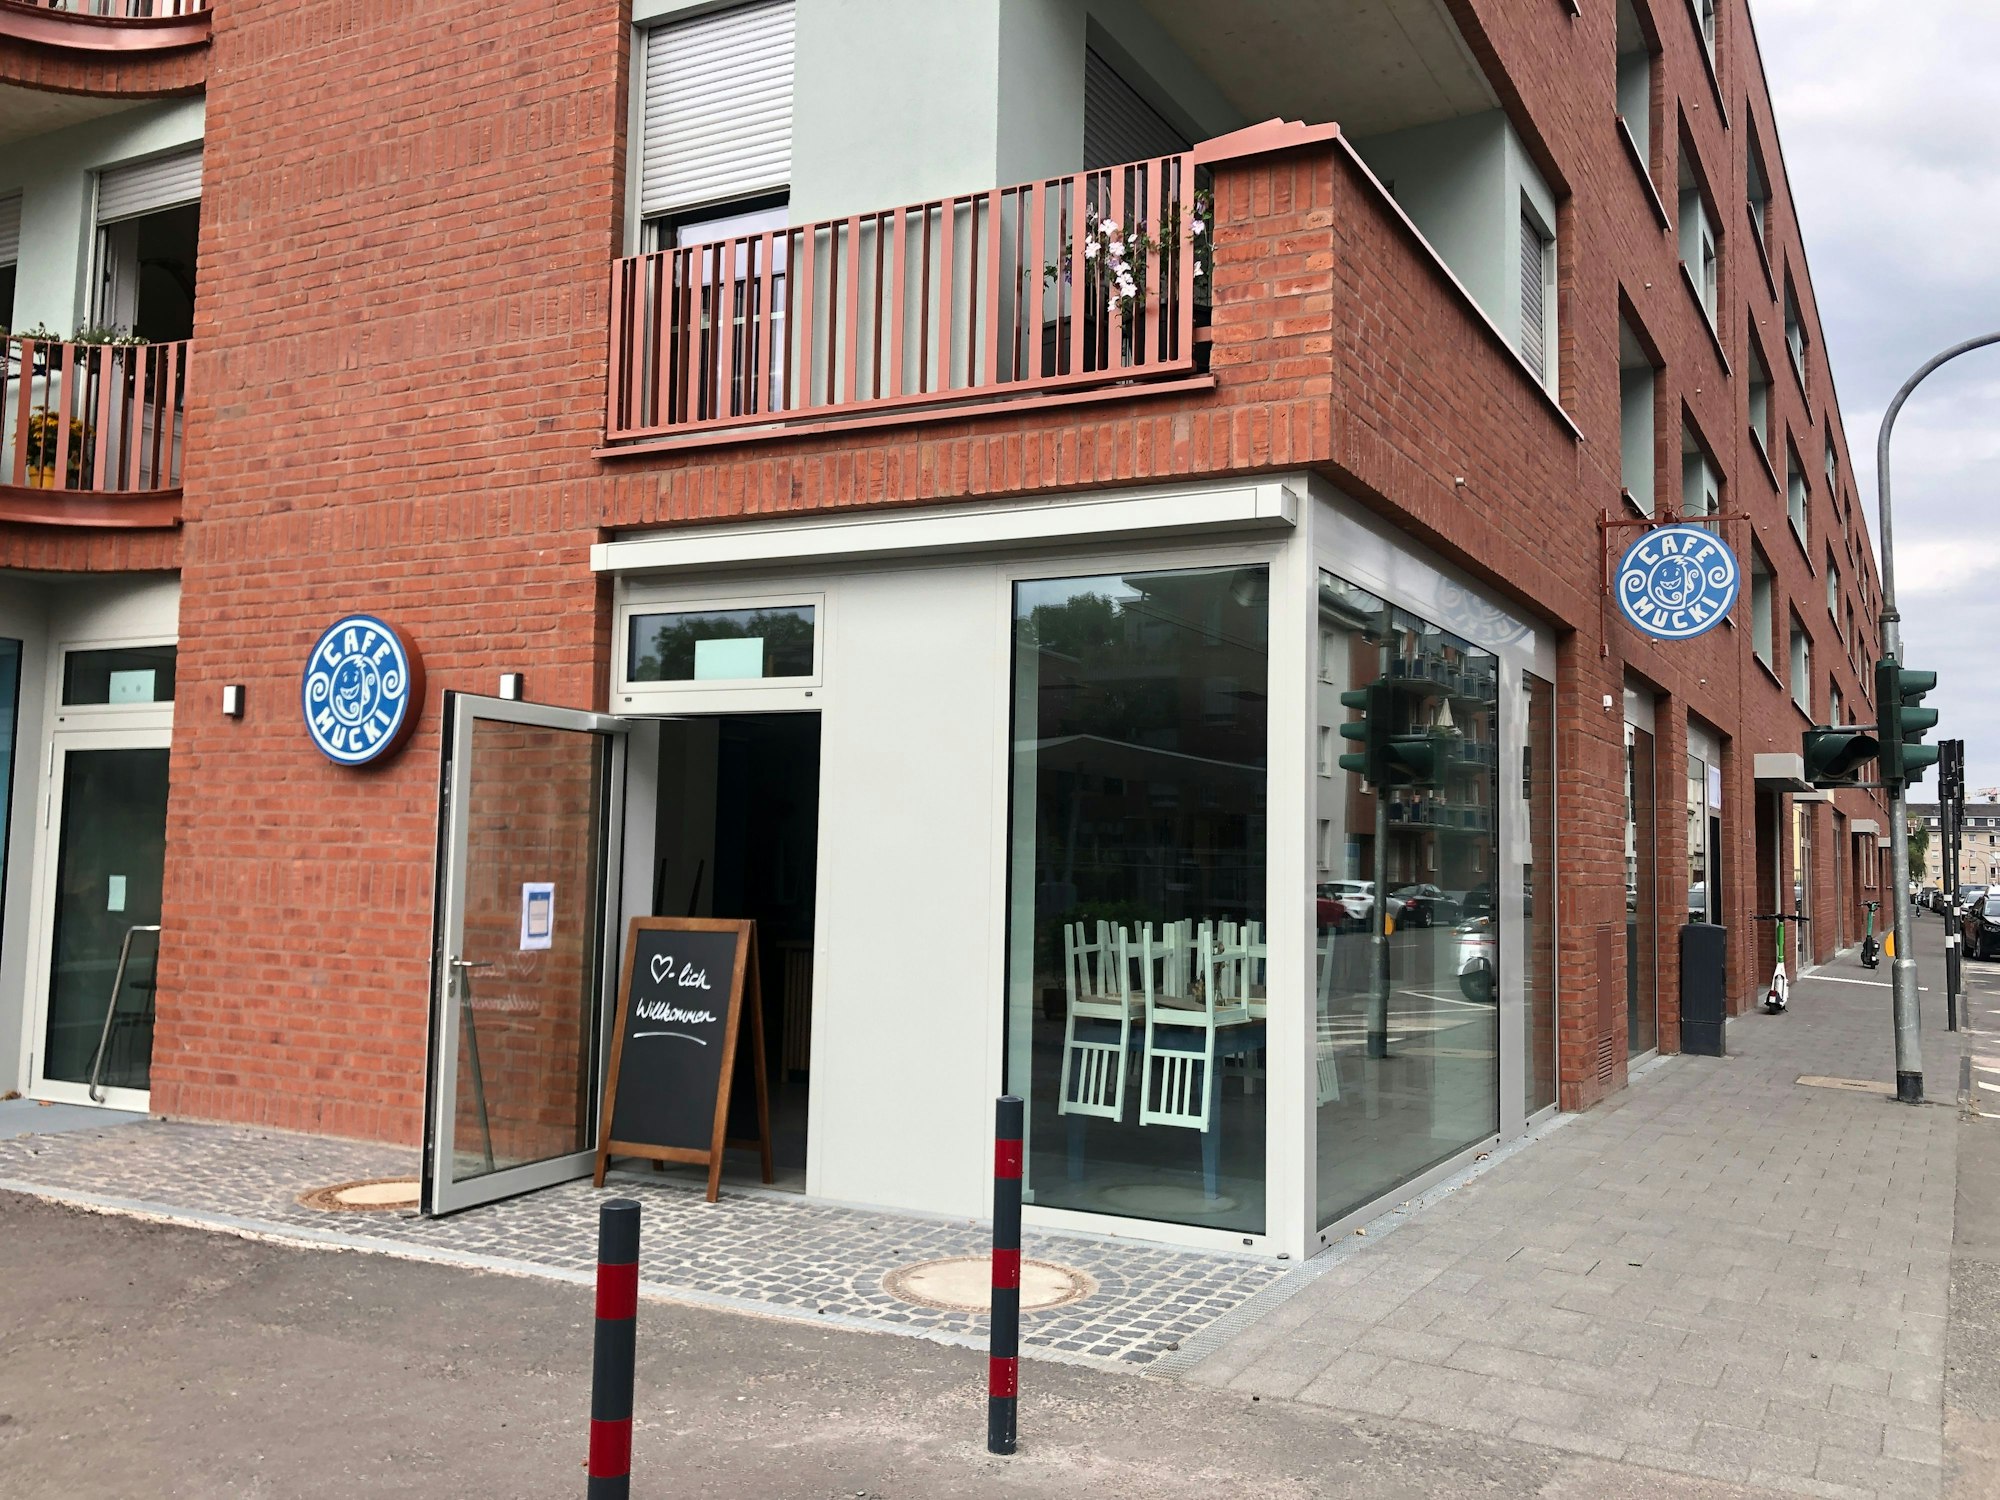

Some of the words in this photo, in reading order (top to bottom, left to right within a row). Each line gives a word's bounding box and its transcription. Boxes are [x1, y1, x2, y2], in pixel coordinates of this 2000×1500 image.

[1638, 535, 1715, 565] CAFE
[1632, 596, 1719, 629] MUCKI
[323, 628, 390, 667] CAFE
[325, 707, 391, 751] MUCKI
[636, 997, 717, 1024] Willkommen
